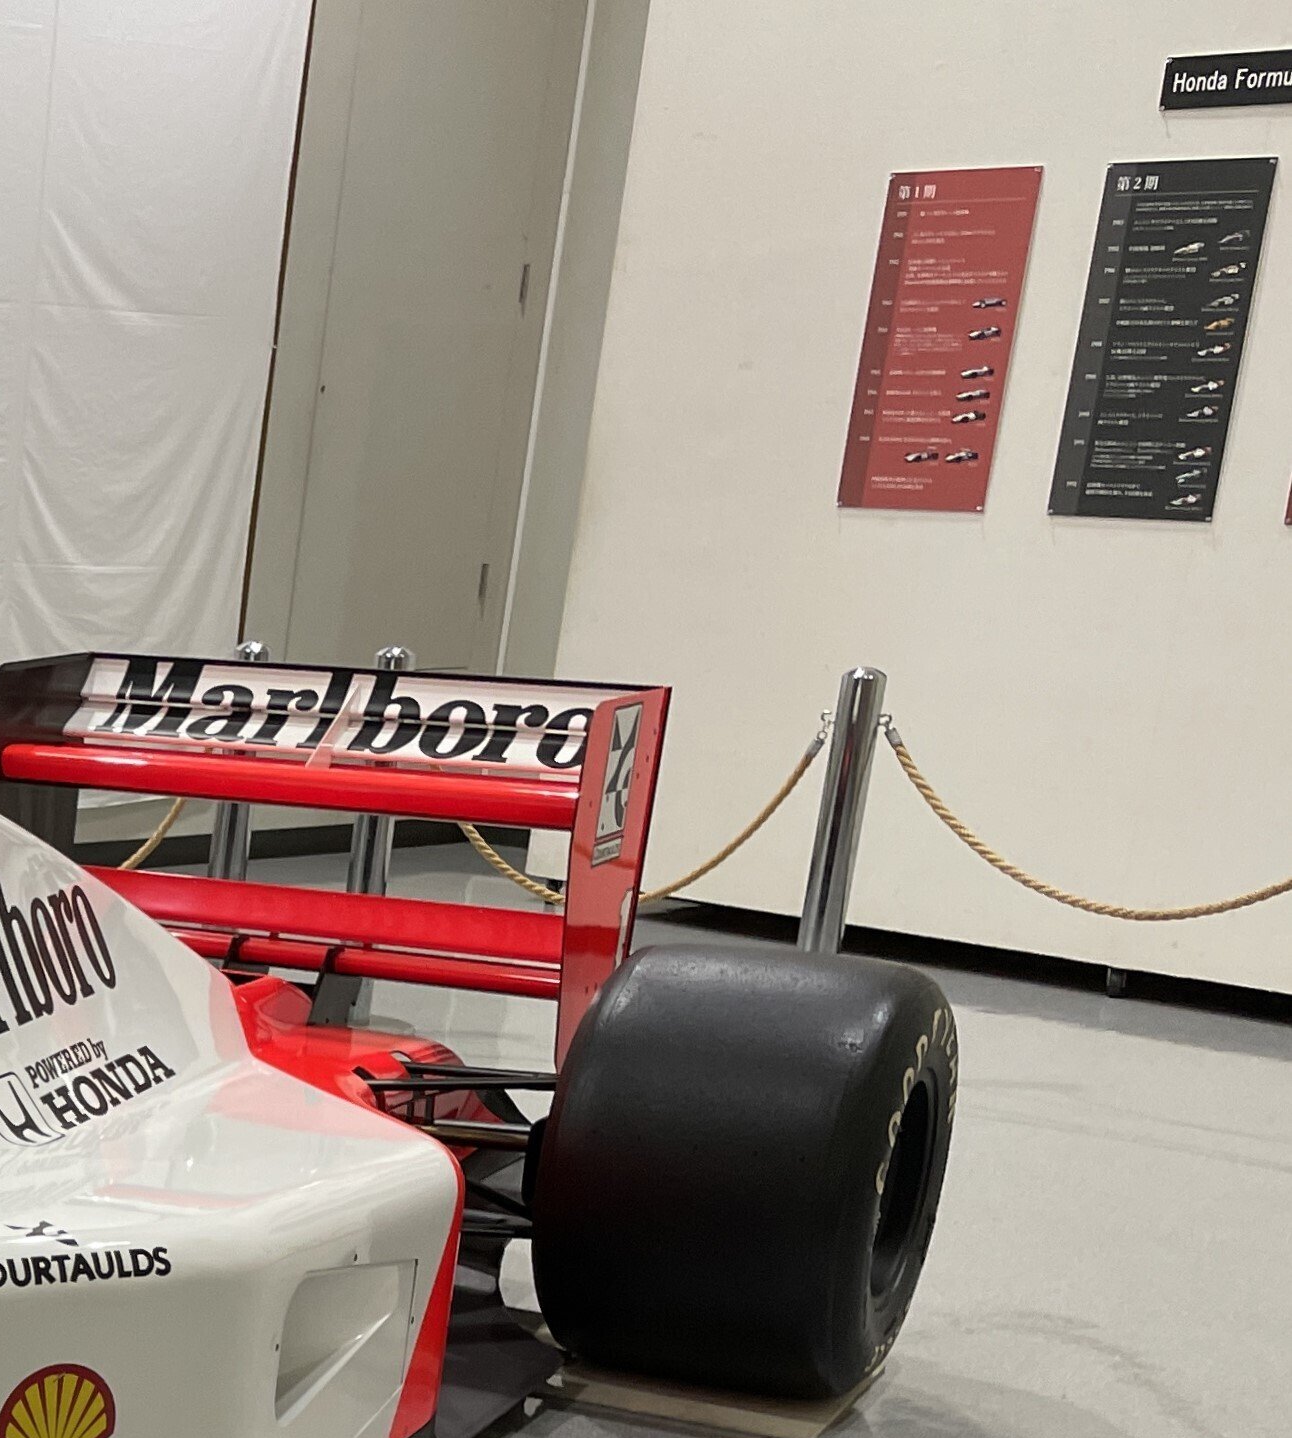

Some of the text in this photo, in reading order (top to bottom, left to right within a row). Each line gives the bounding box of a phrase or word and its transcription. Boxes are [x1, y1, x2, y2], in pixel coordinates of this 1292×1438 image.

[1172, 68, 1292, 93] Honda Formu
[96, 660, 595, 770] Marlboro
[24, 1037, 108, 1089] POWERED by
[39, 1045, 176, 1130] HONDA
